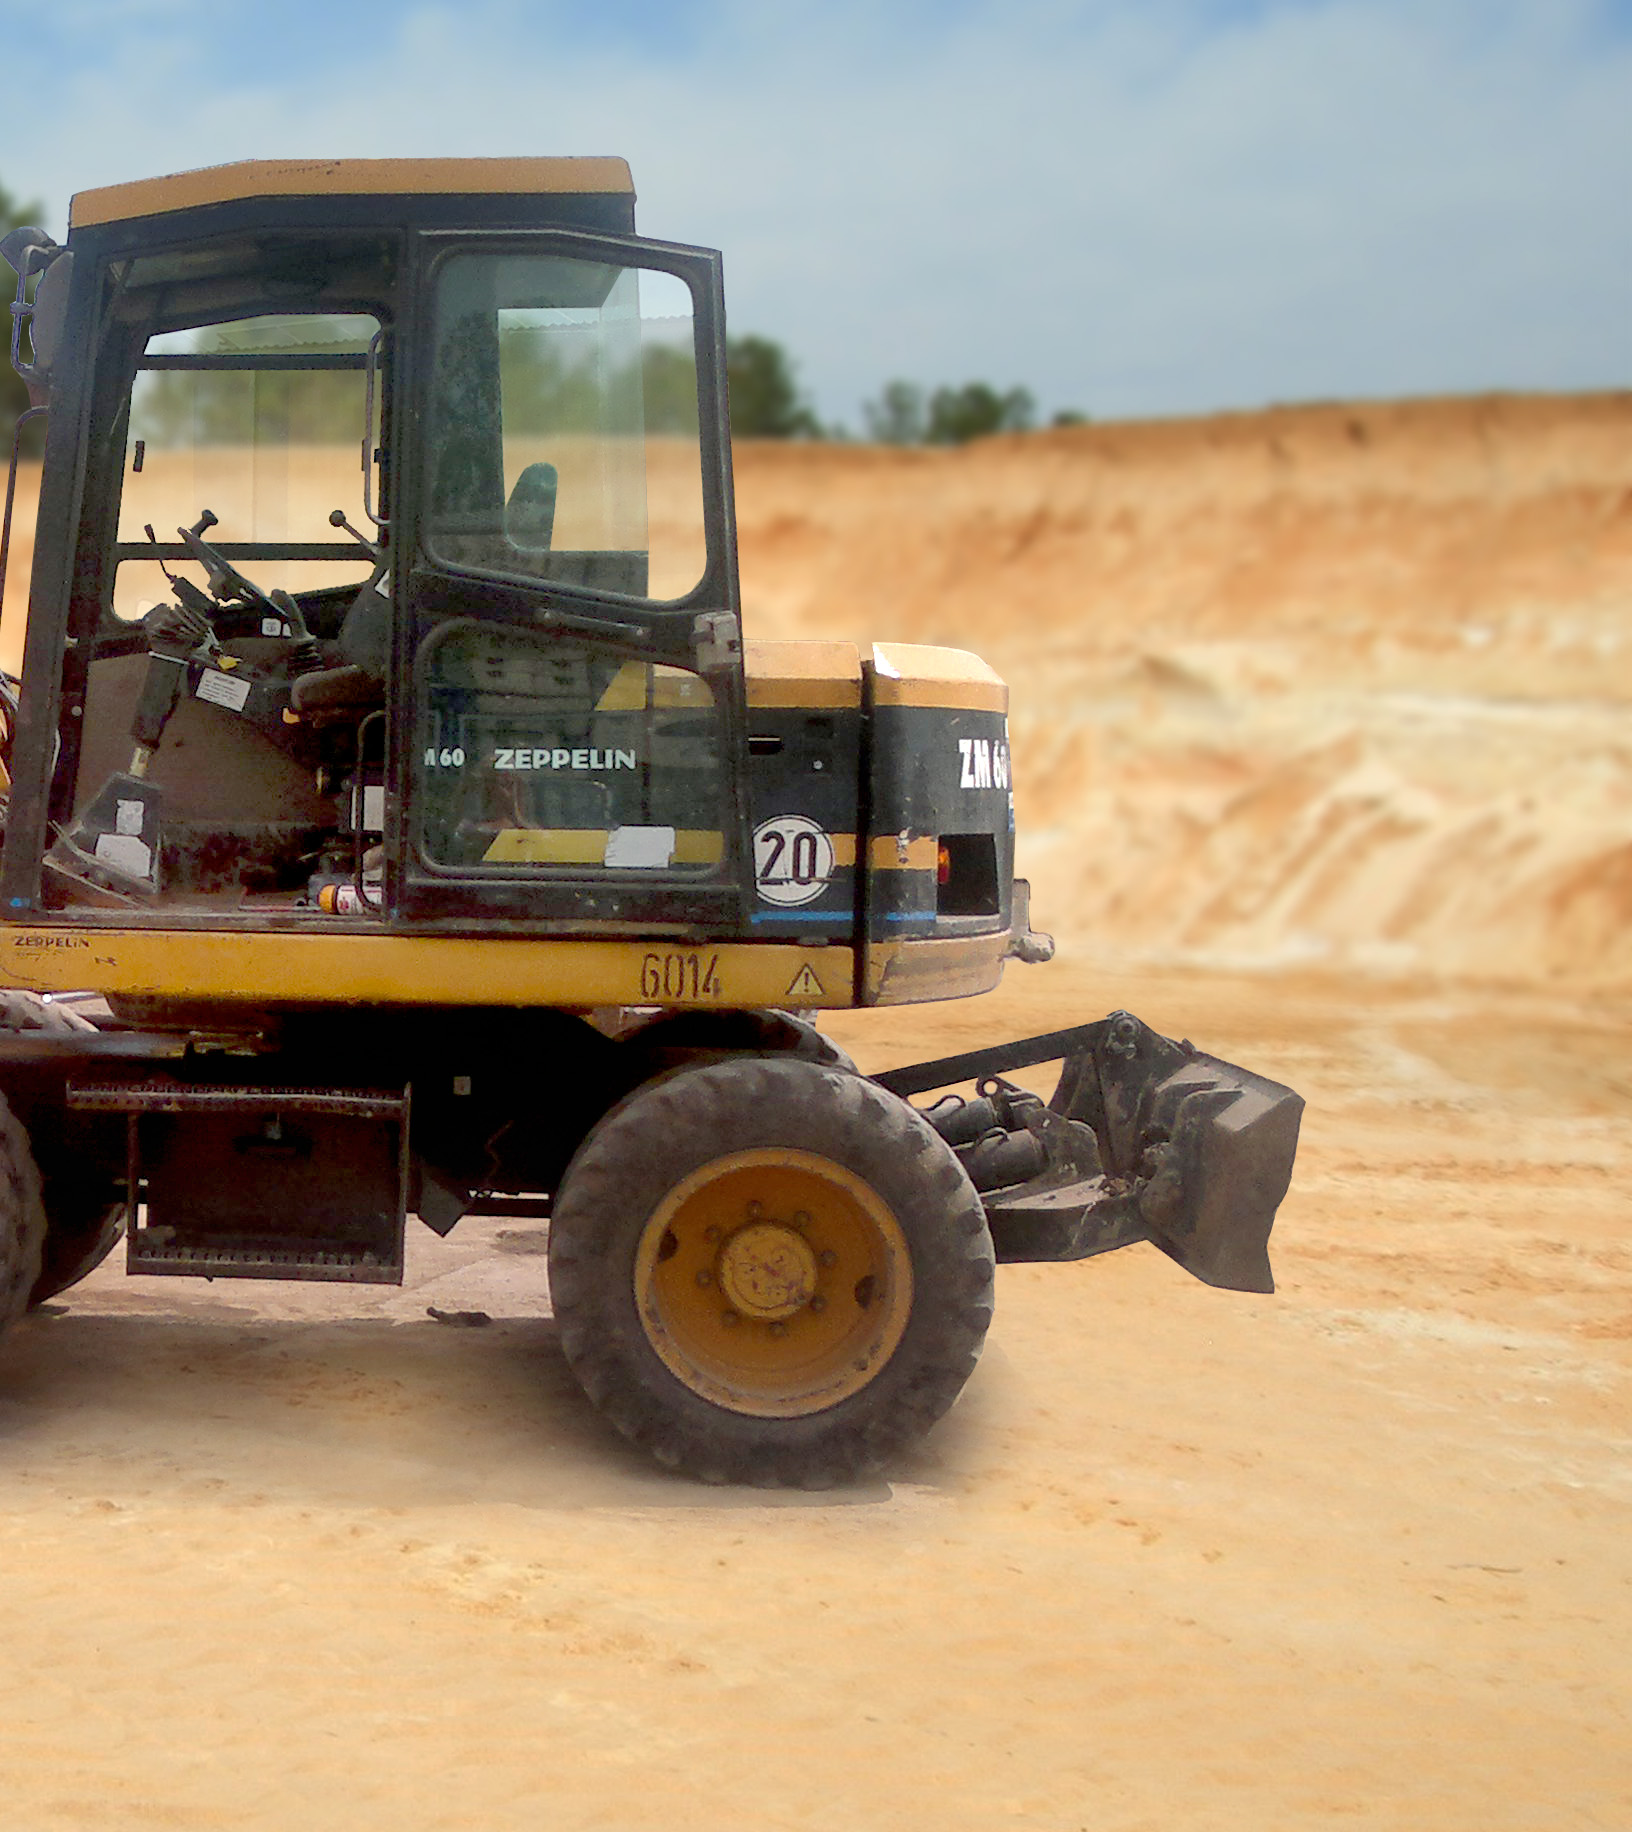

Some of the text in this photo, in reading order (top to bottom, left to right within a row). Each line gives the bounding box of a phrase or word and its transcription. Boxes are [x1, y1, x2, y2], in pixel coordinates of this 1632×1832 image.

[439, 747, 466, 767] 60
[494, 748, 636, 770] ZEPPELIN
[958, 739, 992, 789] ZM
[759, 831, 817, 886] 20
[14, 934, 90, 948] ZEPPELIN
[641, 953, 721, 998] 6014
